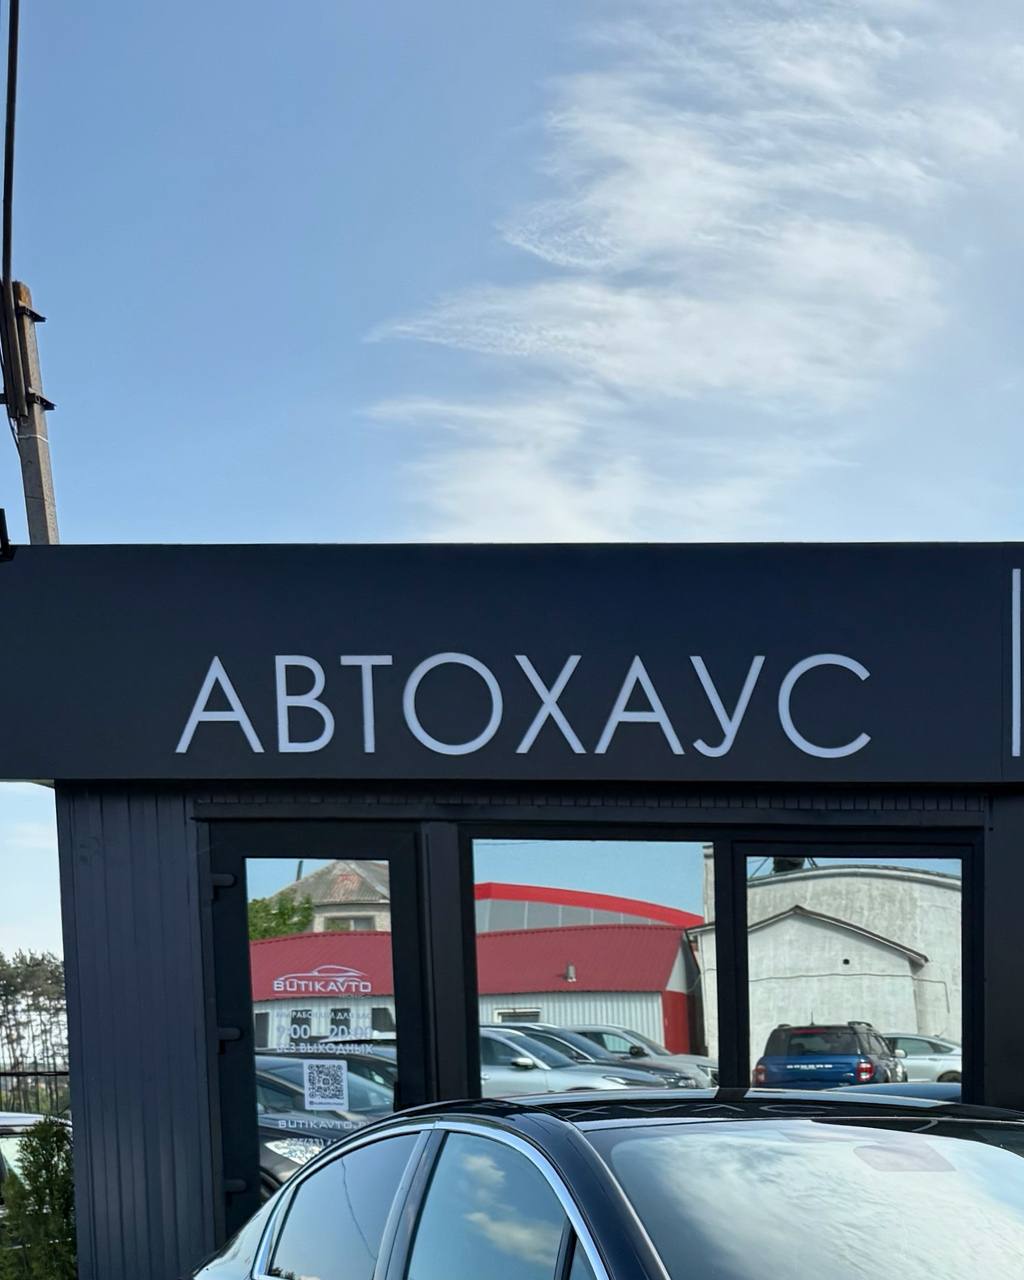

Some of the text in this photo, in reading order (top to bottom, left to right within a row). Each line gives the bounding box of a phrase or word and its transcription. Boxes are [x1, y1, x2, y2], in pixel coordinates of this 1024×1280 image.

[175, 652, 871, 758] АВТОХАУС
[273, 980, 372, 992] BUTIKAVTO
[300, 1043, 374, 1055] ВЫХОДНЫХ
[278, 1119, 371, 1129] BUTIKAVTO.B
